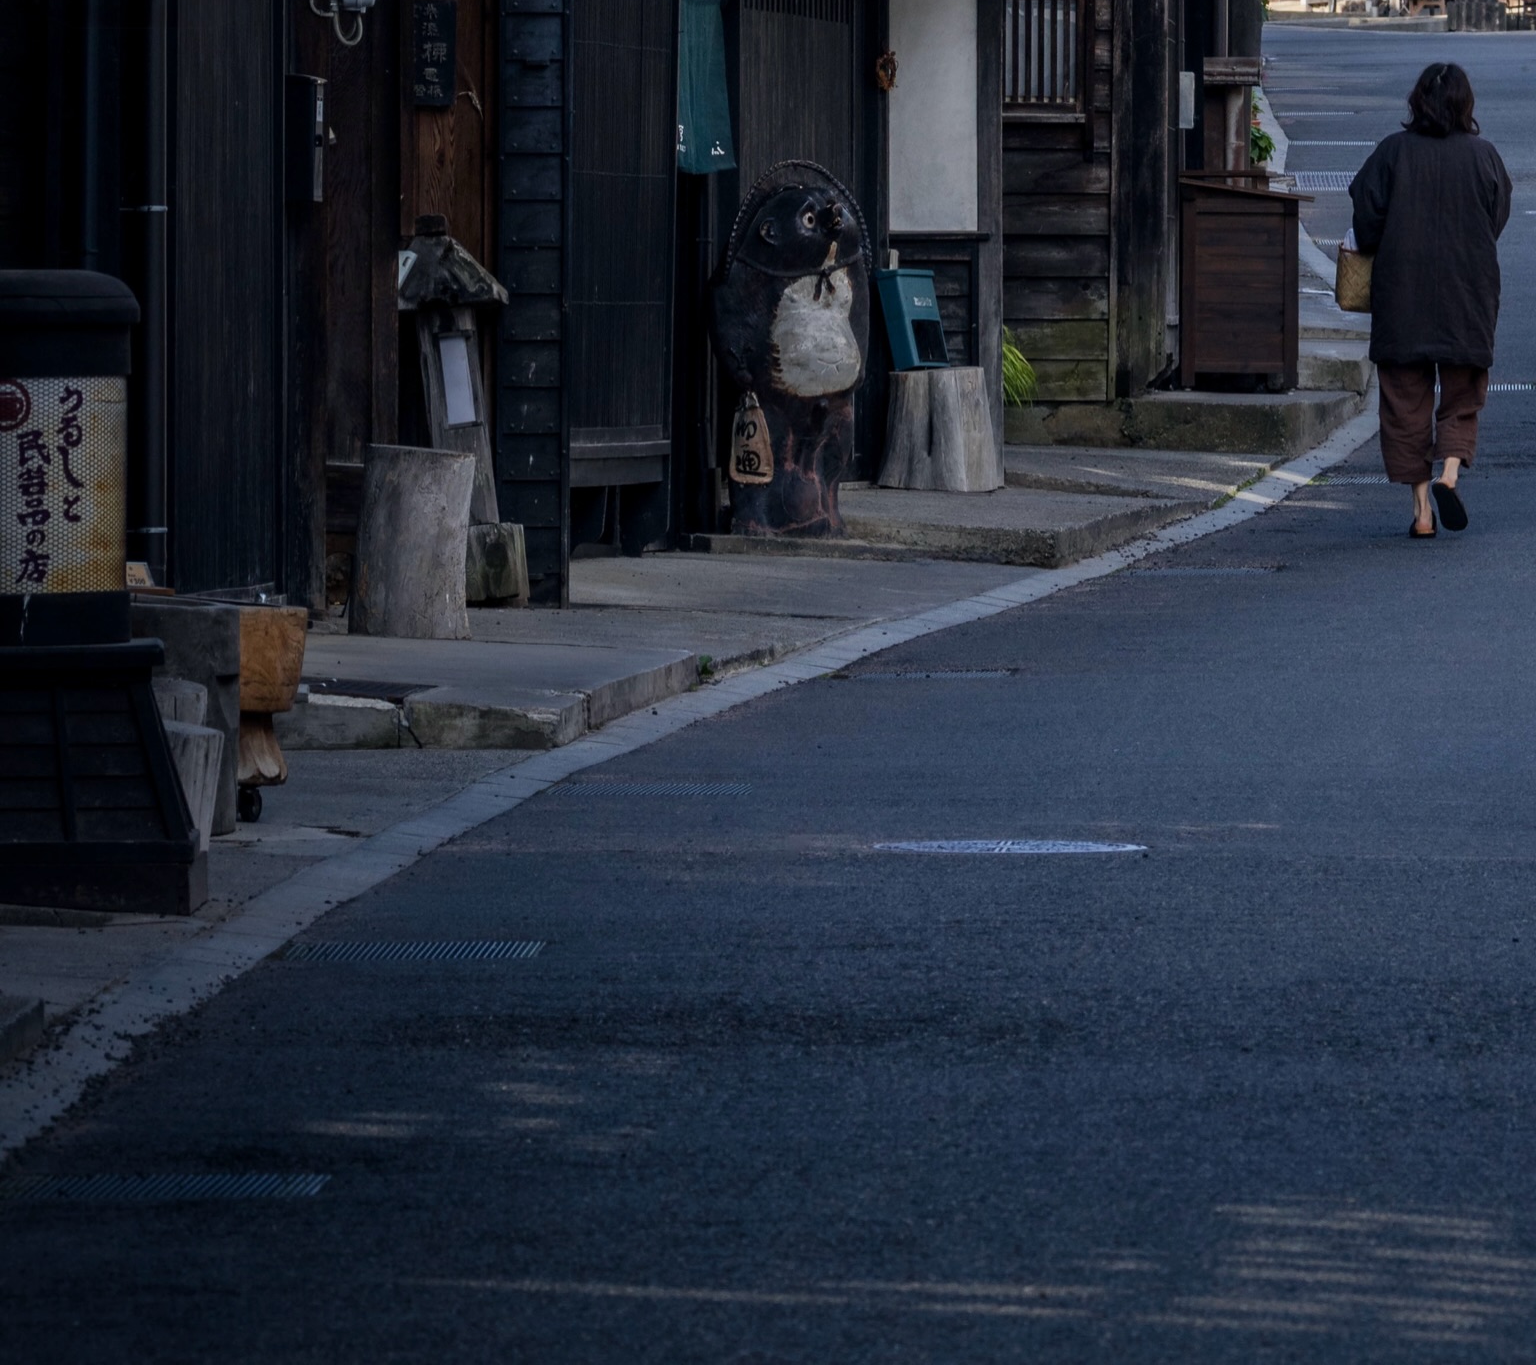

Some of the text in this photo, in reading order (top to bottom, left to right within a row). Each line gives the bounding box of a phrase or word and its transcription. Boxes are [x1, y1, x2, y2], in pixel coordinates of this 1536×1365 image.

[15, 430, 51, 585] 民芸品の店
[56, 385, 84, 523] うるしと
